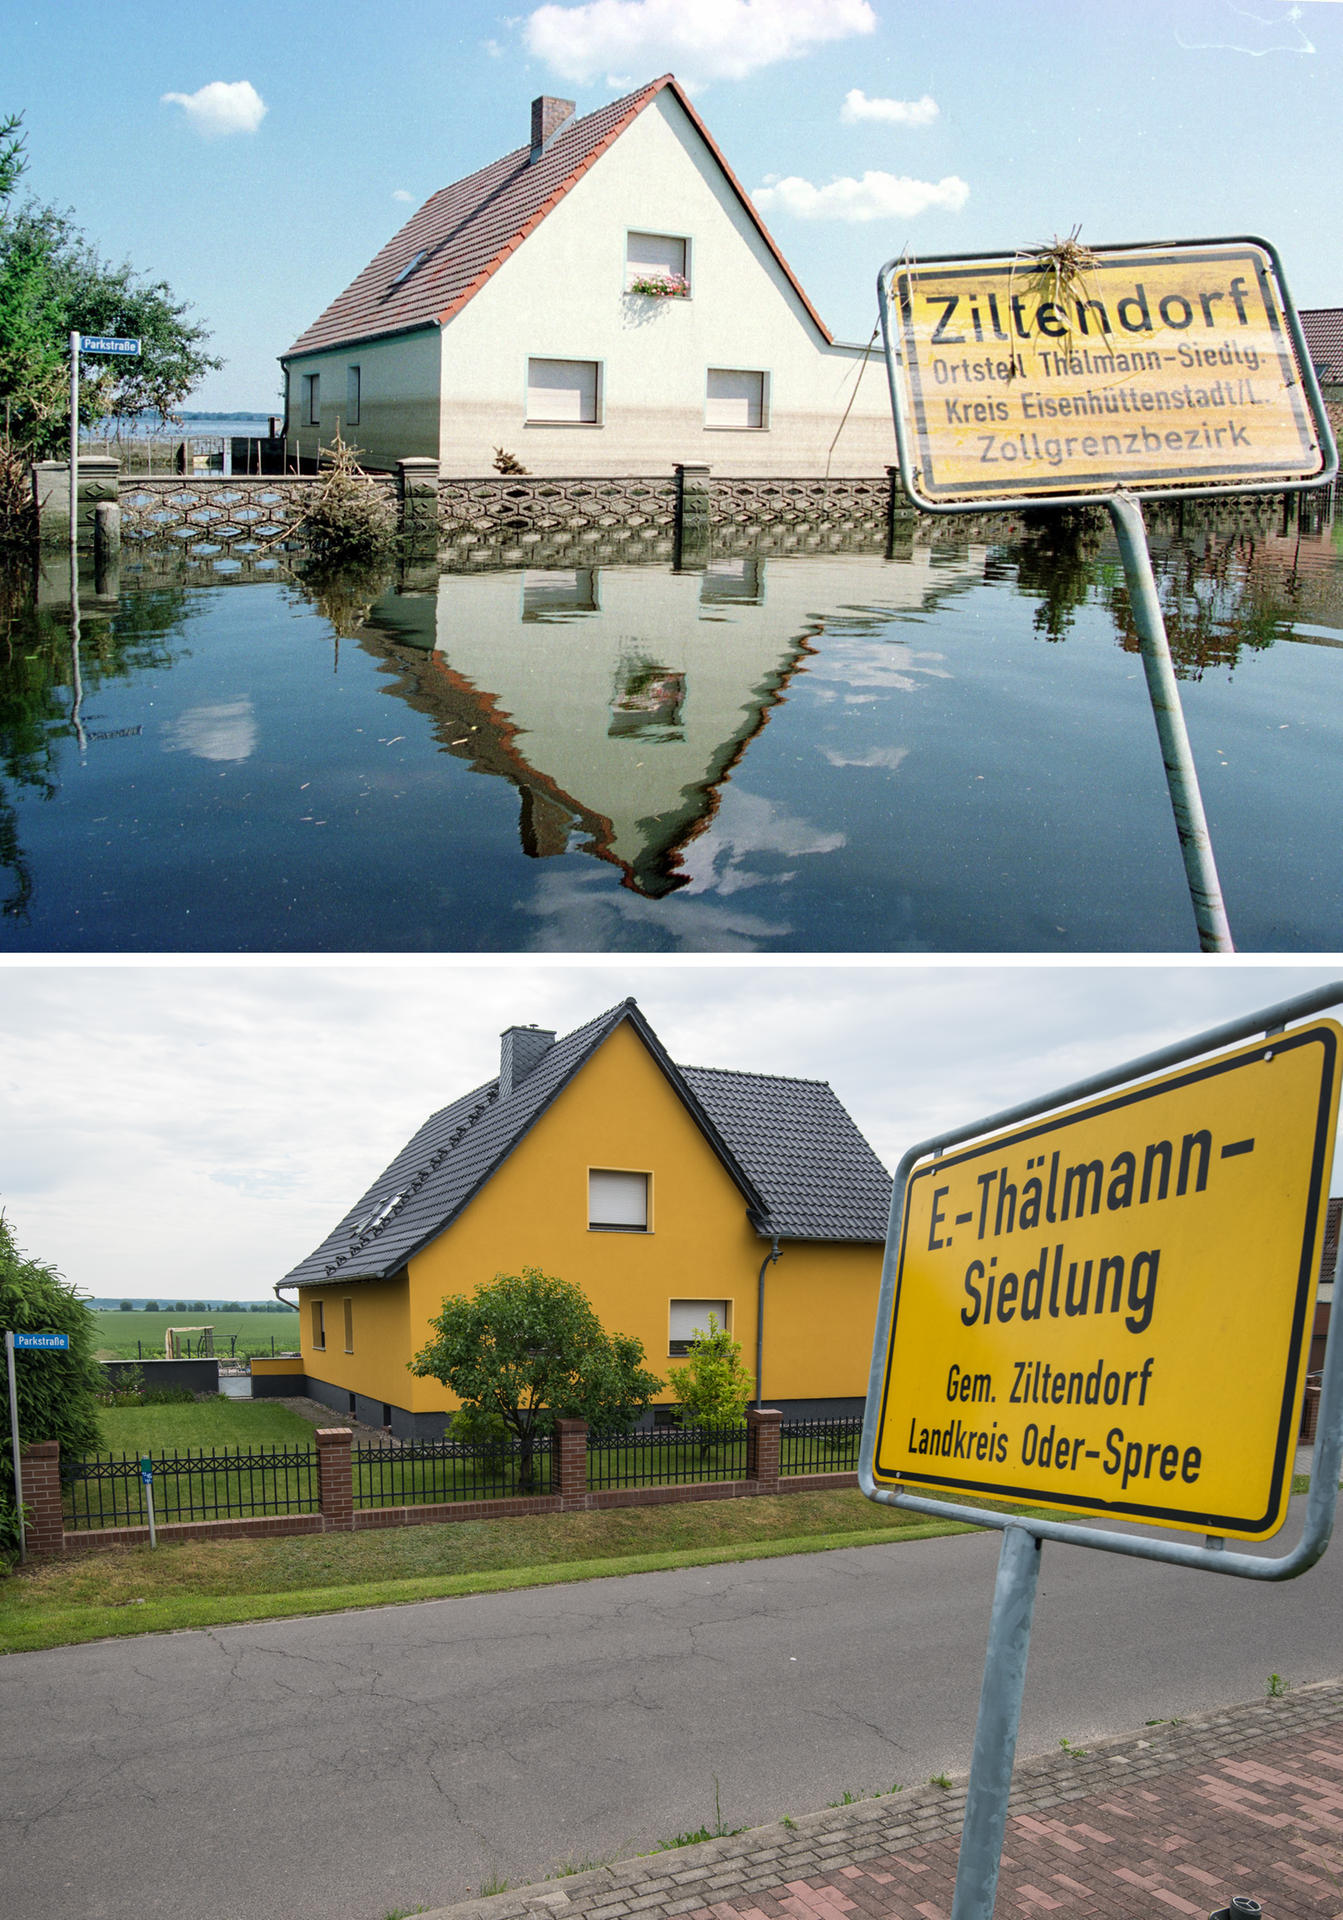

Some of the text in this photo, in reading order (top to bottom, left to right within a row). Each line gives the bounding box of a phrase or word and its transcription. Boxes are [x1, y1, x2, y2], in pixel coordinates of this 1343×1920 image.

[926, 278, 1249, 345] Ziltendorf
[84, 339, 136, 351] Parkstraße
[1043, 341, 1268, 378] Thälmann-Siedlg.
[945, 394, 1010, 424] Kreis
[977, 421, 1251, 466] Zollgrenzbezirk
[927, 1129, 1255, 1251] E.-Thälmann-
[960, 1243, 1161, 1335] Siedlung
[18, 1336, 65, 1346] Parkstraße
[946, 1357, 1154, 1406] Gem. Ziltendorf
[907, 1417, 1202, 1490] Landkreis Oder-Spree
